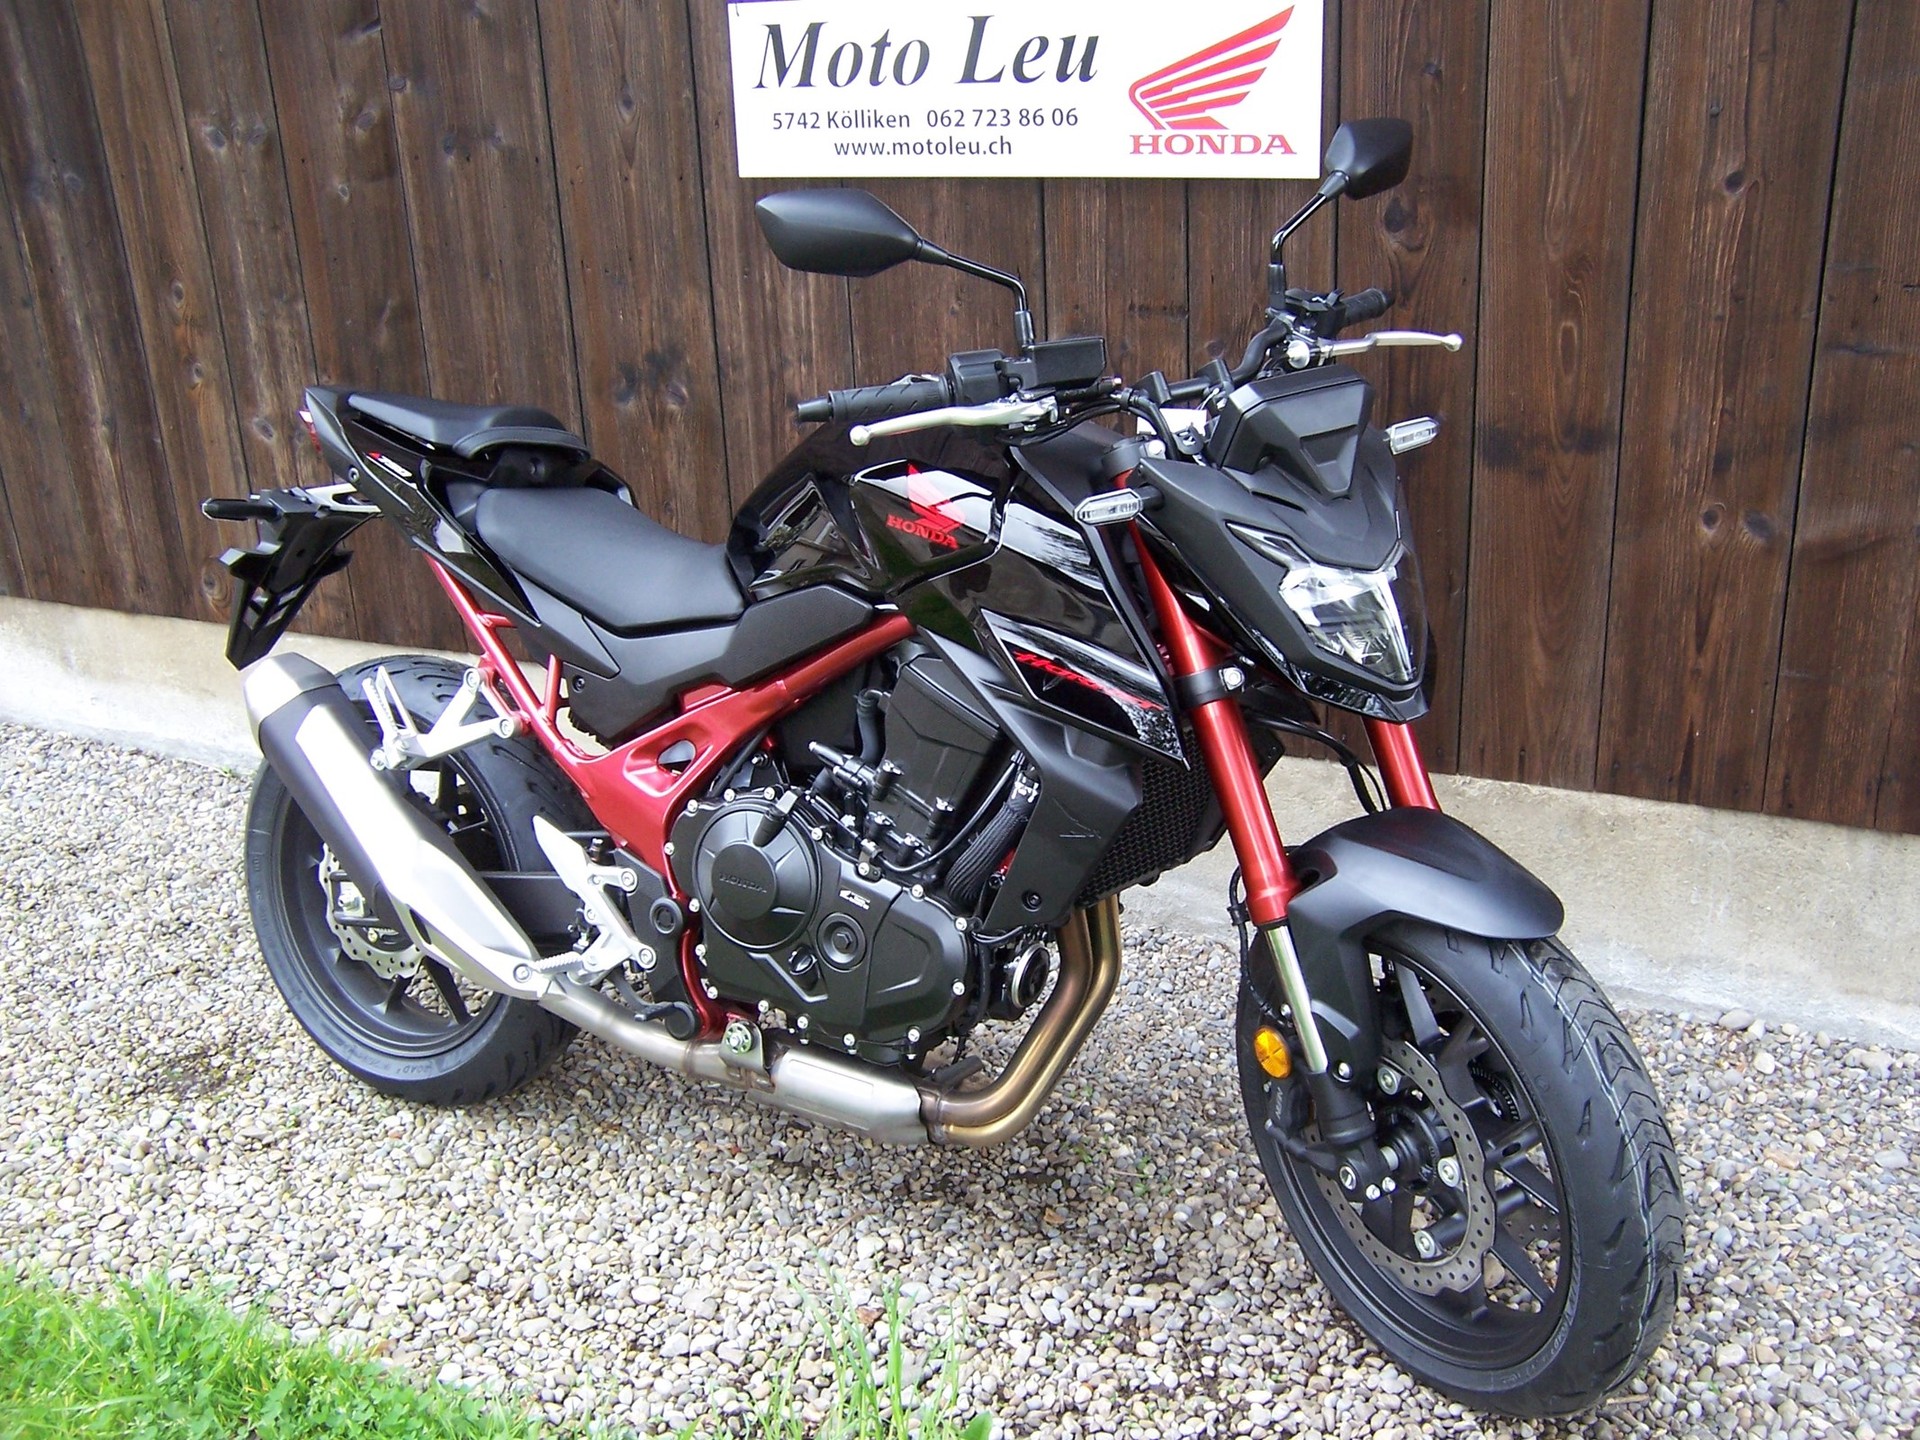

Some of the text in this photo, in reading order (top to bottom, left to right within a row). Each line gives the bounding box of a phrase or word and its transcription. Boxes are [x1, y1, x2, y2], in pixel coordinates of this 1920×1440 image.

[752, 15, 1100, 89] Moto Leu
[772, 107, 1079, 129] 5742 Kölliken 062 723 86 06
[834, 136, 1012, 156] www.motoleu.ch
[1130, 133, 1297, 155] HONDA
[884, 513, 959, 549] HONDA
